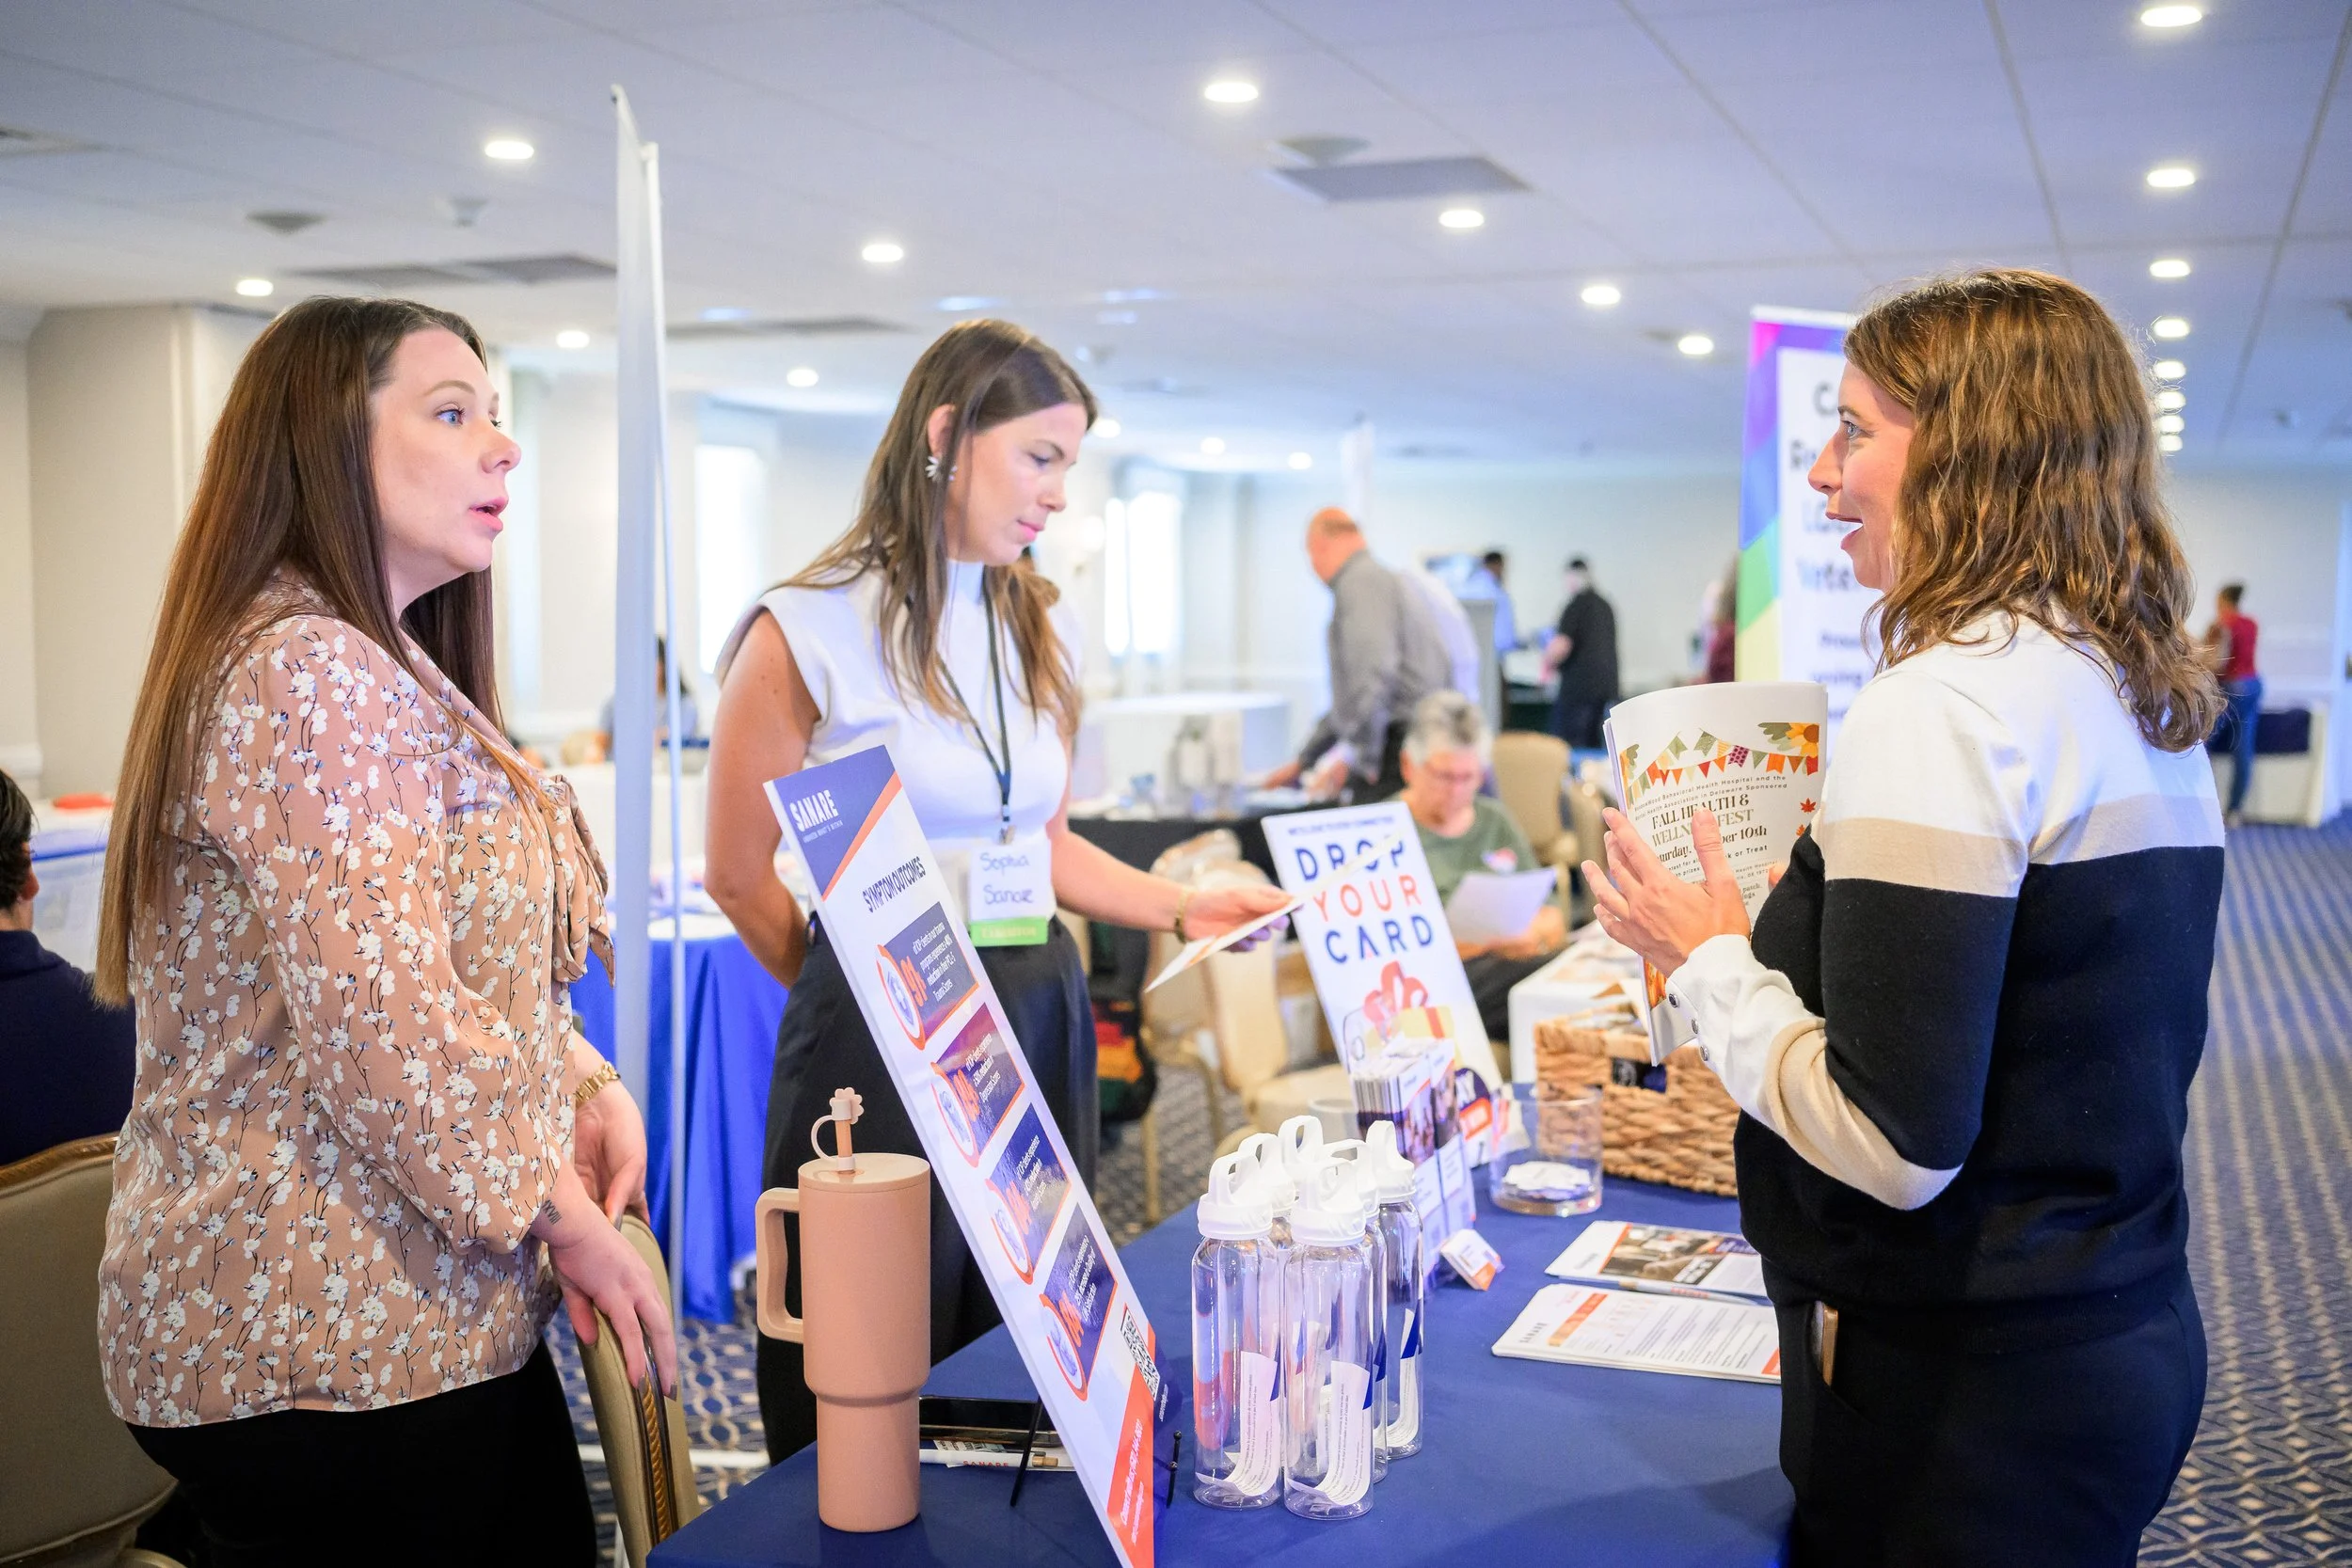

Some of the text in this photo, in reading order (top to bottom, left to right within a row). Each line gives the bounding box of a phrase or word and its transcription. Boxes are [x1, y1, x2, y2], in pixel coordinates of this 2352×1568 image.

[1662, 788, 1693, 800] Behavioral
[1696, 782, 1718, 790] Health
[1721, 777, 1753, 787] Hospital
[1664, 796, 1698, 809] Association
[1709, 786, 1742, 797] Delaware
[789, 789, 839, 832] SANARE
[1652, 810, 1679, 830] FALL
[1740, 794, 1749, 806] &
[1718, 809, 1754, 828] FEST
[1740, 826, 1767, 840] 10th
[1295, 839, 1406, 881] DROP
[1746, 846, 1768, 854] Treat
[862, 856, 926, 912] SYMPTOM OUTCOMES
[1683, 867, 1700, 877] prizes
[1312, 875, 1422, 922] YOUR
[1326, 914, 1434, 964] CARD
